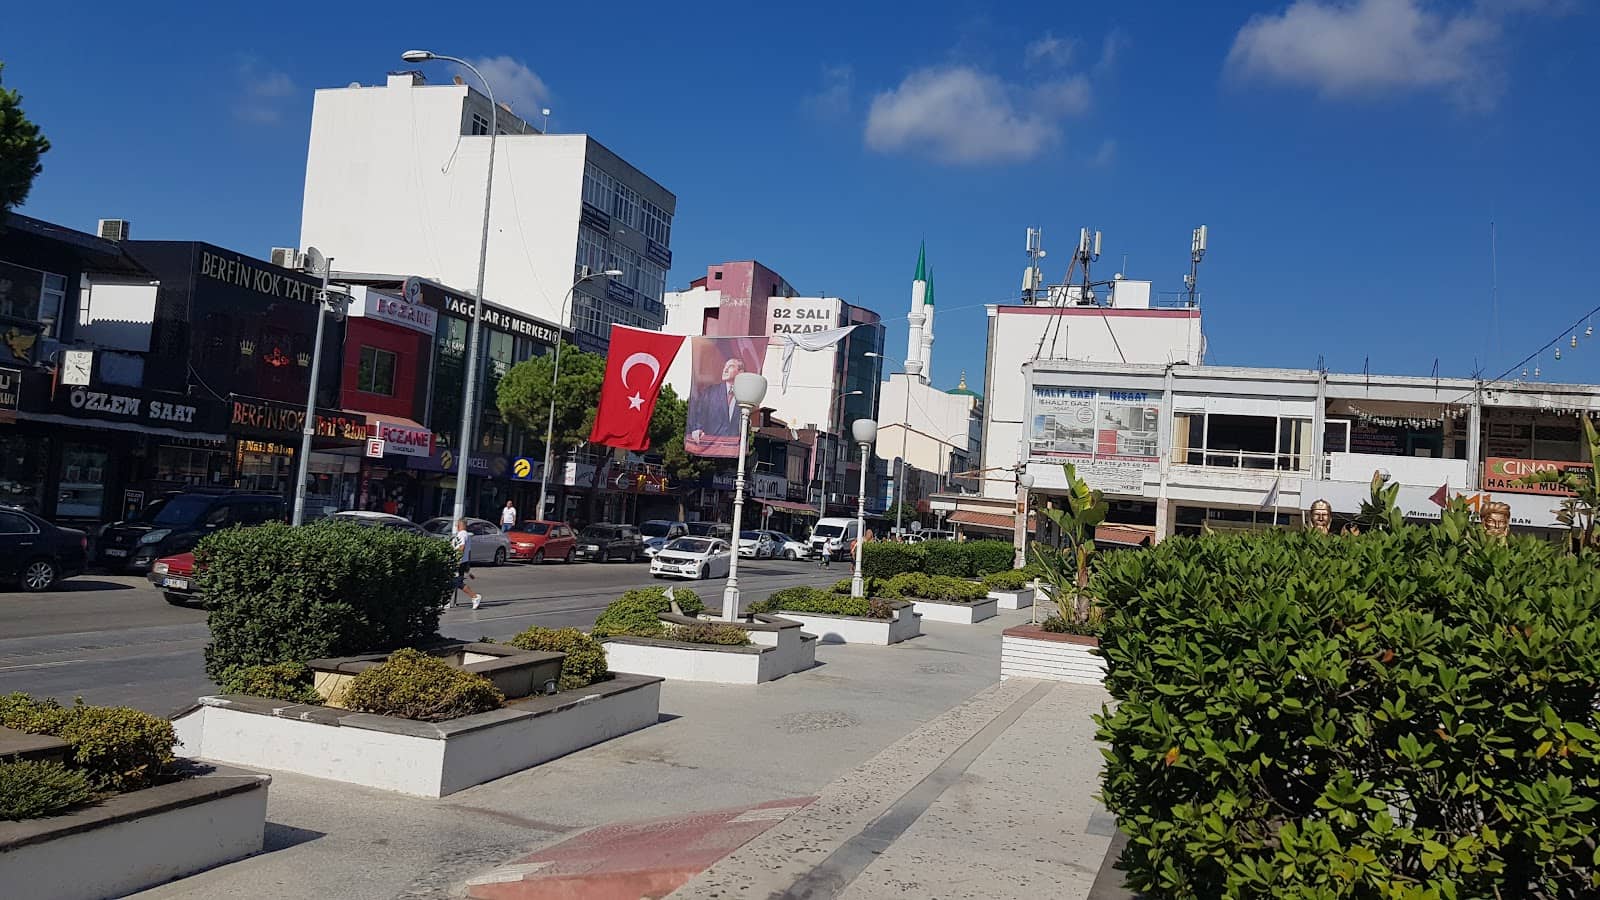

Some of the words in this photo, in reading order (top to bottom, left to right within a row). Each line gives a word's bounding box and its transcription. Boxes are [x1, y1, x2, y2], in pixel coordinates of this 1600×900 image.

[201, 251, 252, 289] BERFİN
[252, 269, 280, 297] KOK
[773, 308, 791, 319] 82
[796, 309, 830, 320] SALI
[70, 385, 141, 416] ÖZLEM
[150, 400, 196, 423] SAAT
[381, 426, 429, 447] ECZANE
[370, 443, 380, 455] E
